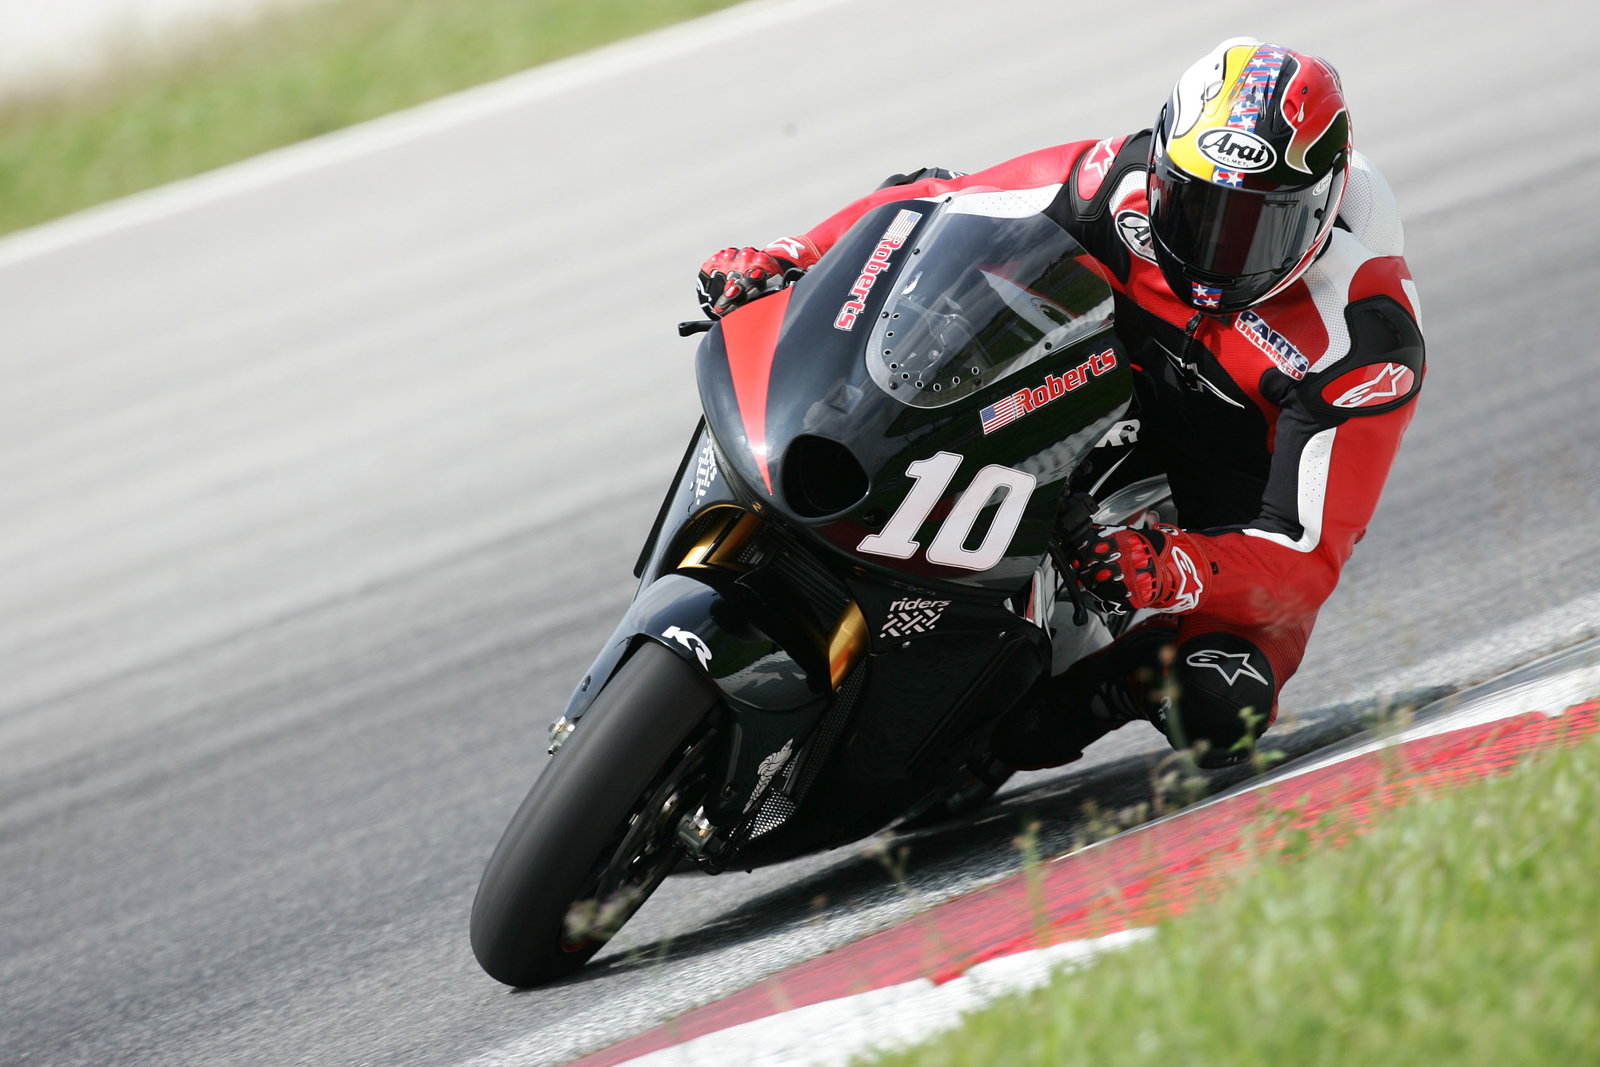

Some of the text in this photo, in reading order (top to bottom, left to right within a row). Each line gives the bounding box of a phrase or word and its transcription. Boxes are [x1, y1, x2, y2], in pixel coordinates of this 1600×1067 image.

[1201, 132, 1267, 163] Arai
[1217, 154, 1248, 167] HELMET
[833, 231, 907, 331] Roberts
[1234, 319, 1304, 380] UNLIMITED
[1239, 310, 1309, 373] PARTS
[1012, 348, 1118, 421] Roberts
[856, 450, 1037, 572] 10
[889, 597, 952, 612] riders
